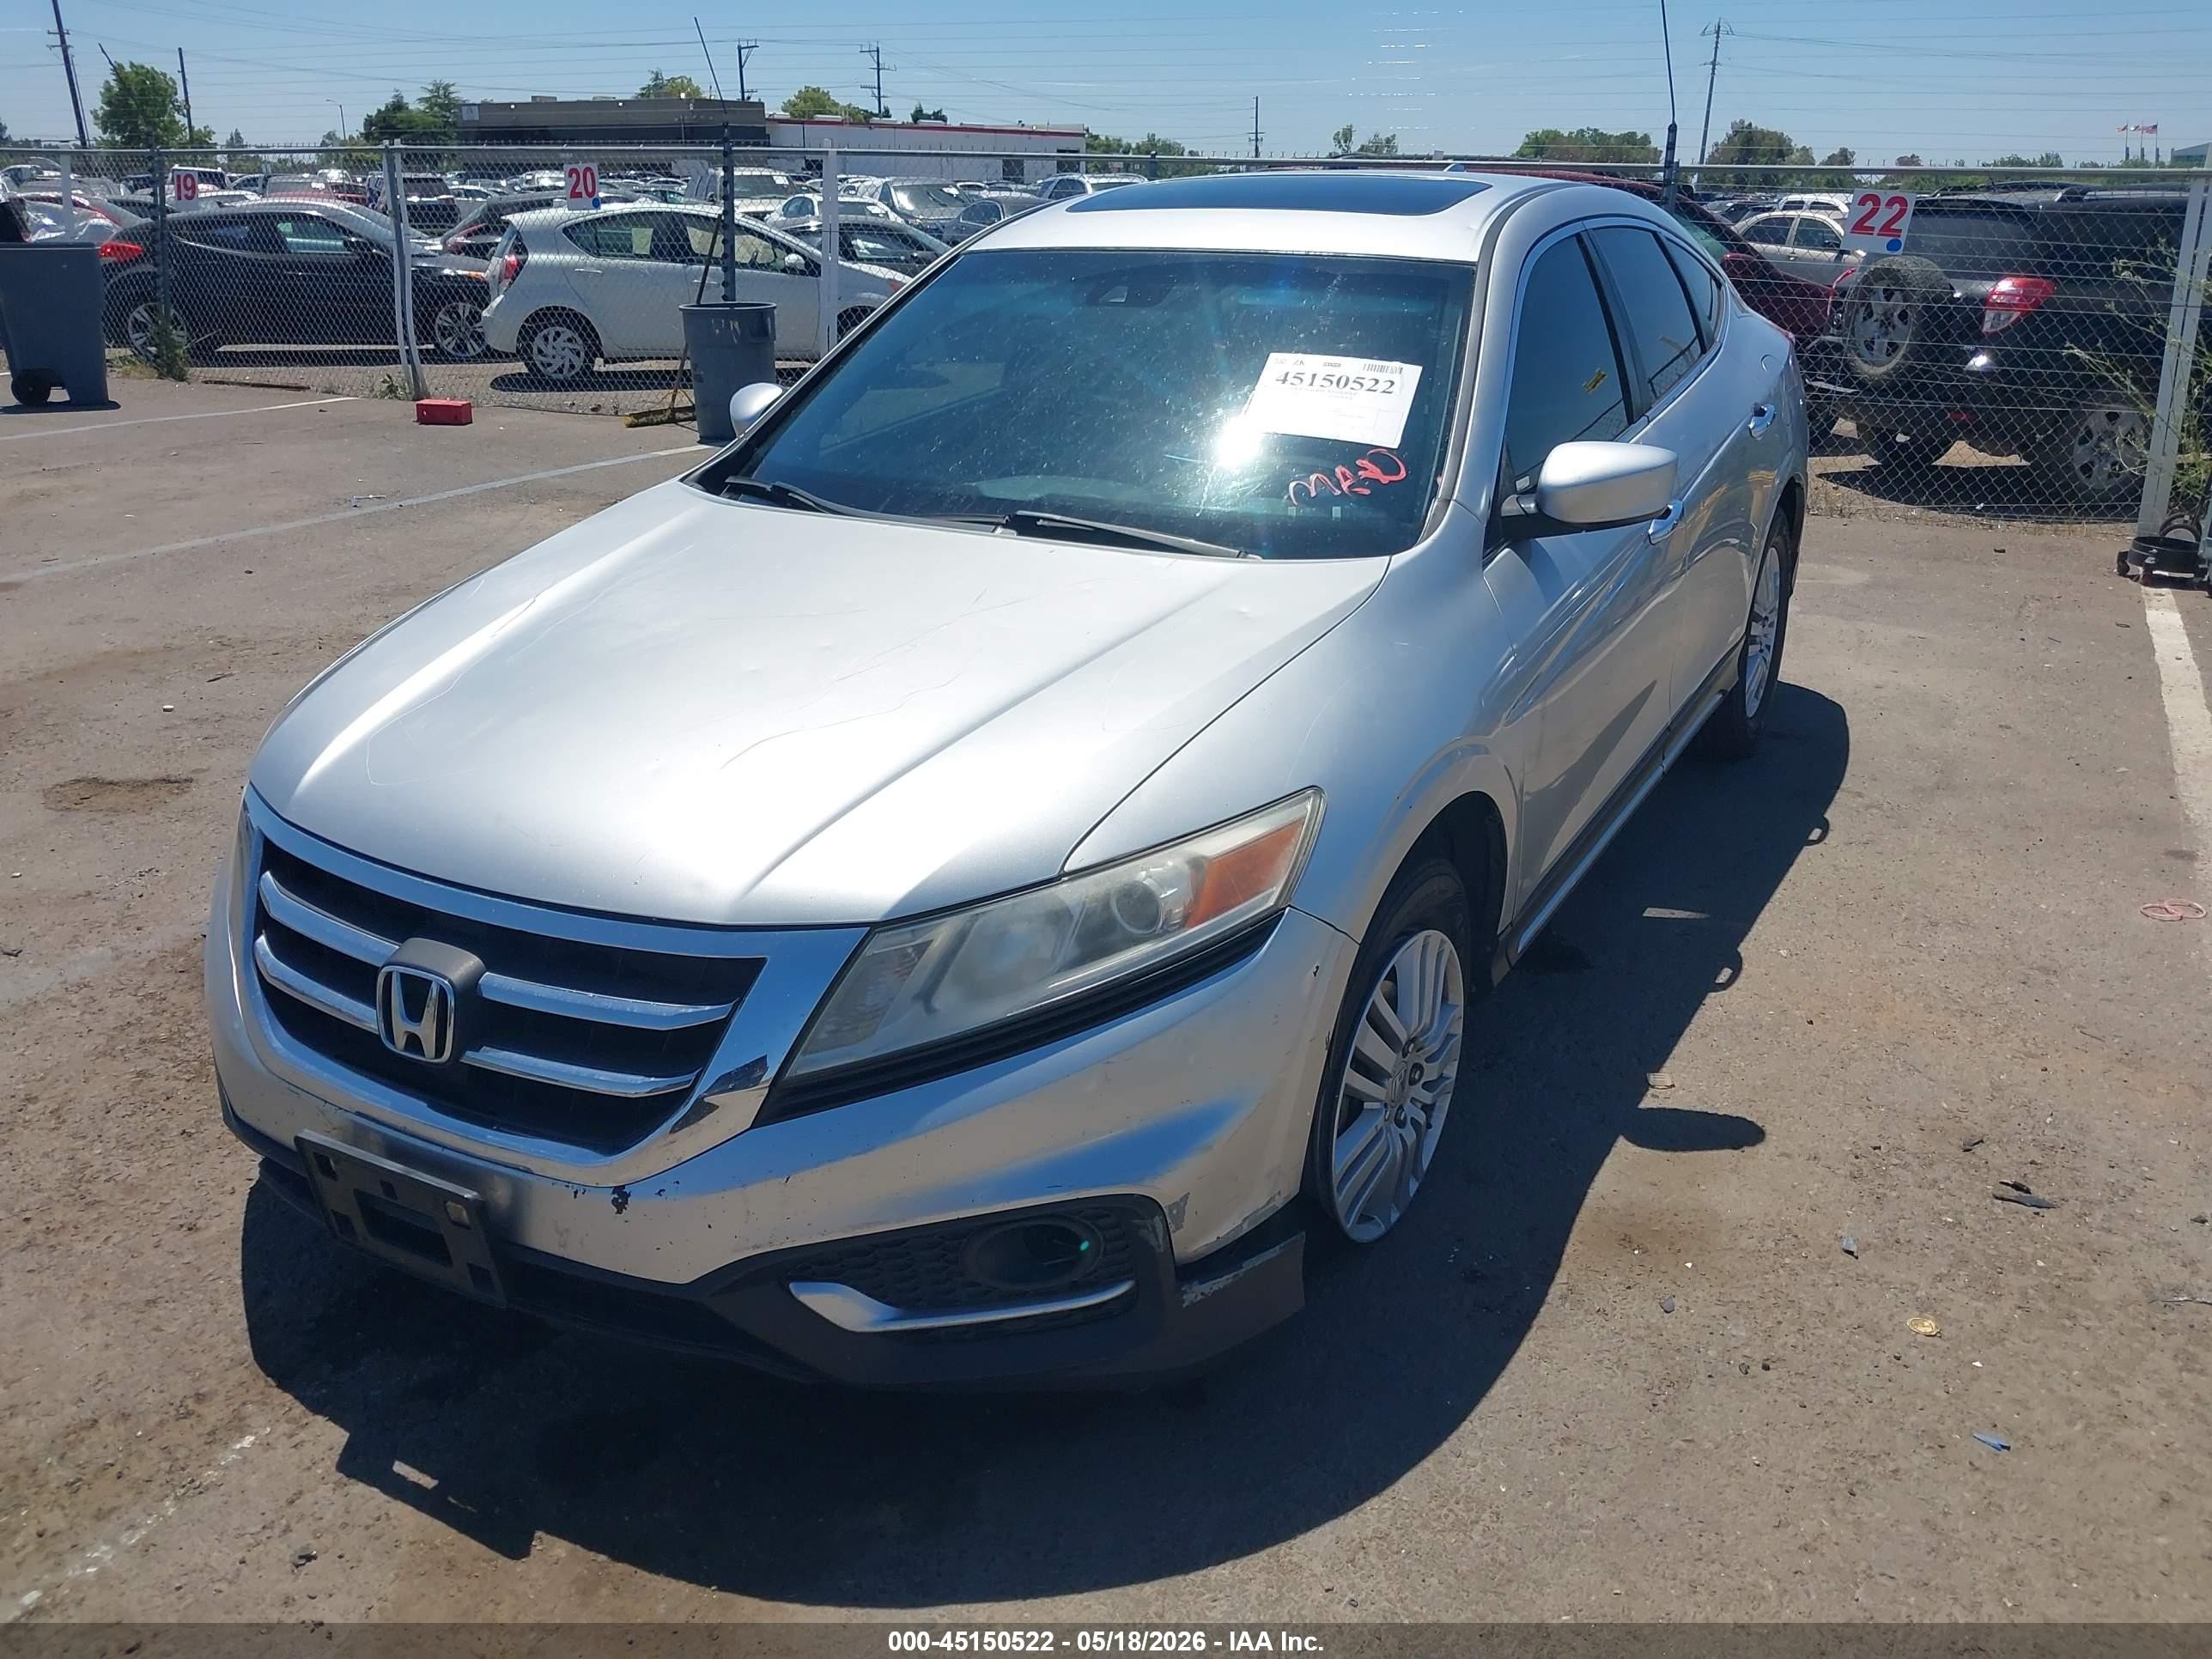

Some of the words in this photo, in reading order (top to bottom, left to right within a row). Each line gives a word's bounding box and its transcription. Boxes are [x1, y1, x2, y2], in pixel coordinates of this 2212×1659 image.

[176, 173, 198, 200] 19
[568, 167, 598, 198] 20
[1850, 194, 1909, 237] 22
[1275, 370, 1395, 395] 45150522
